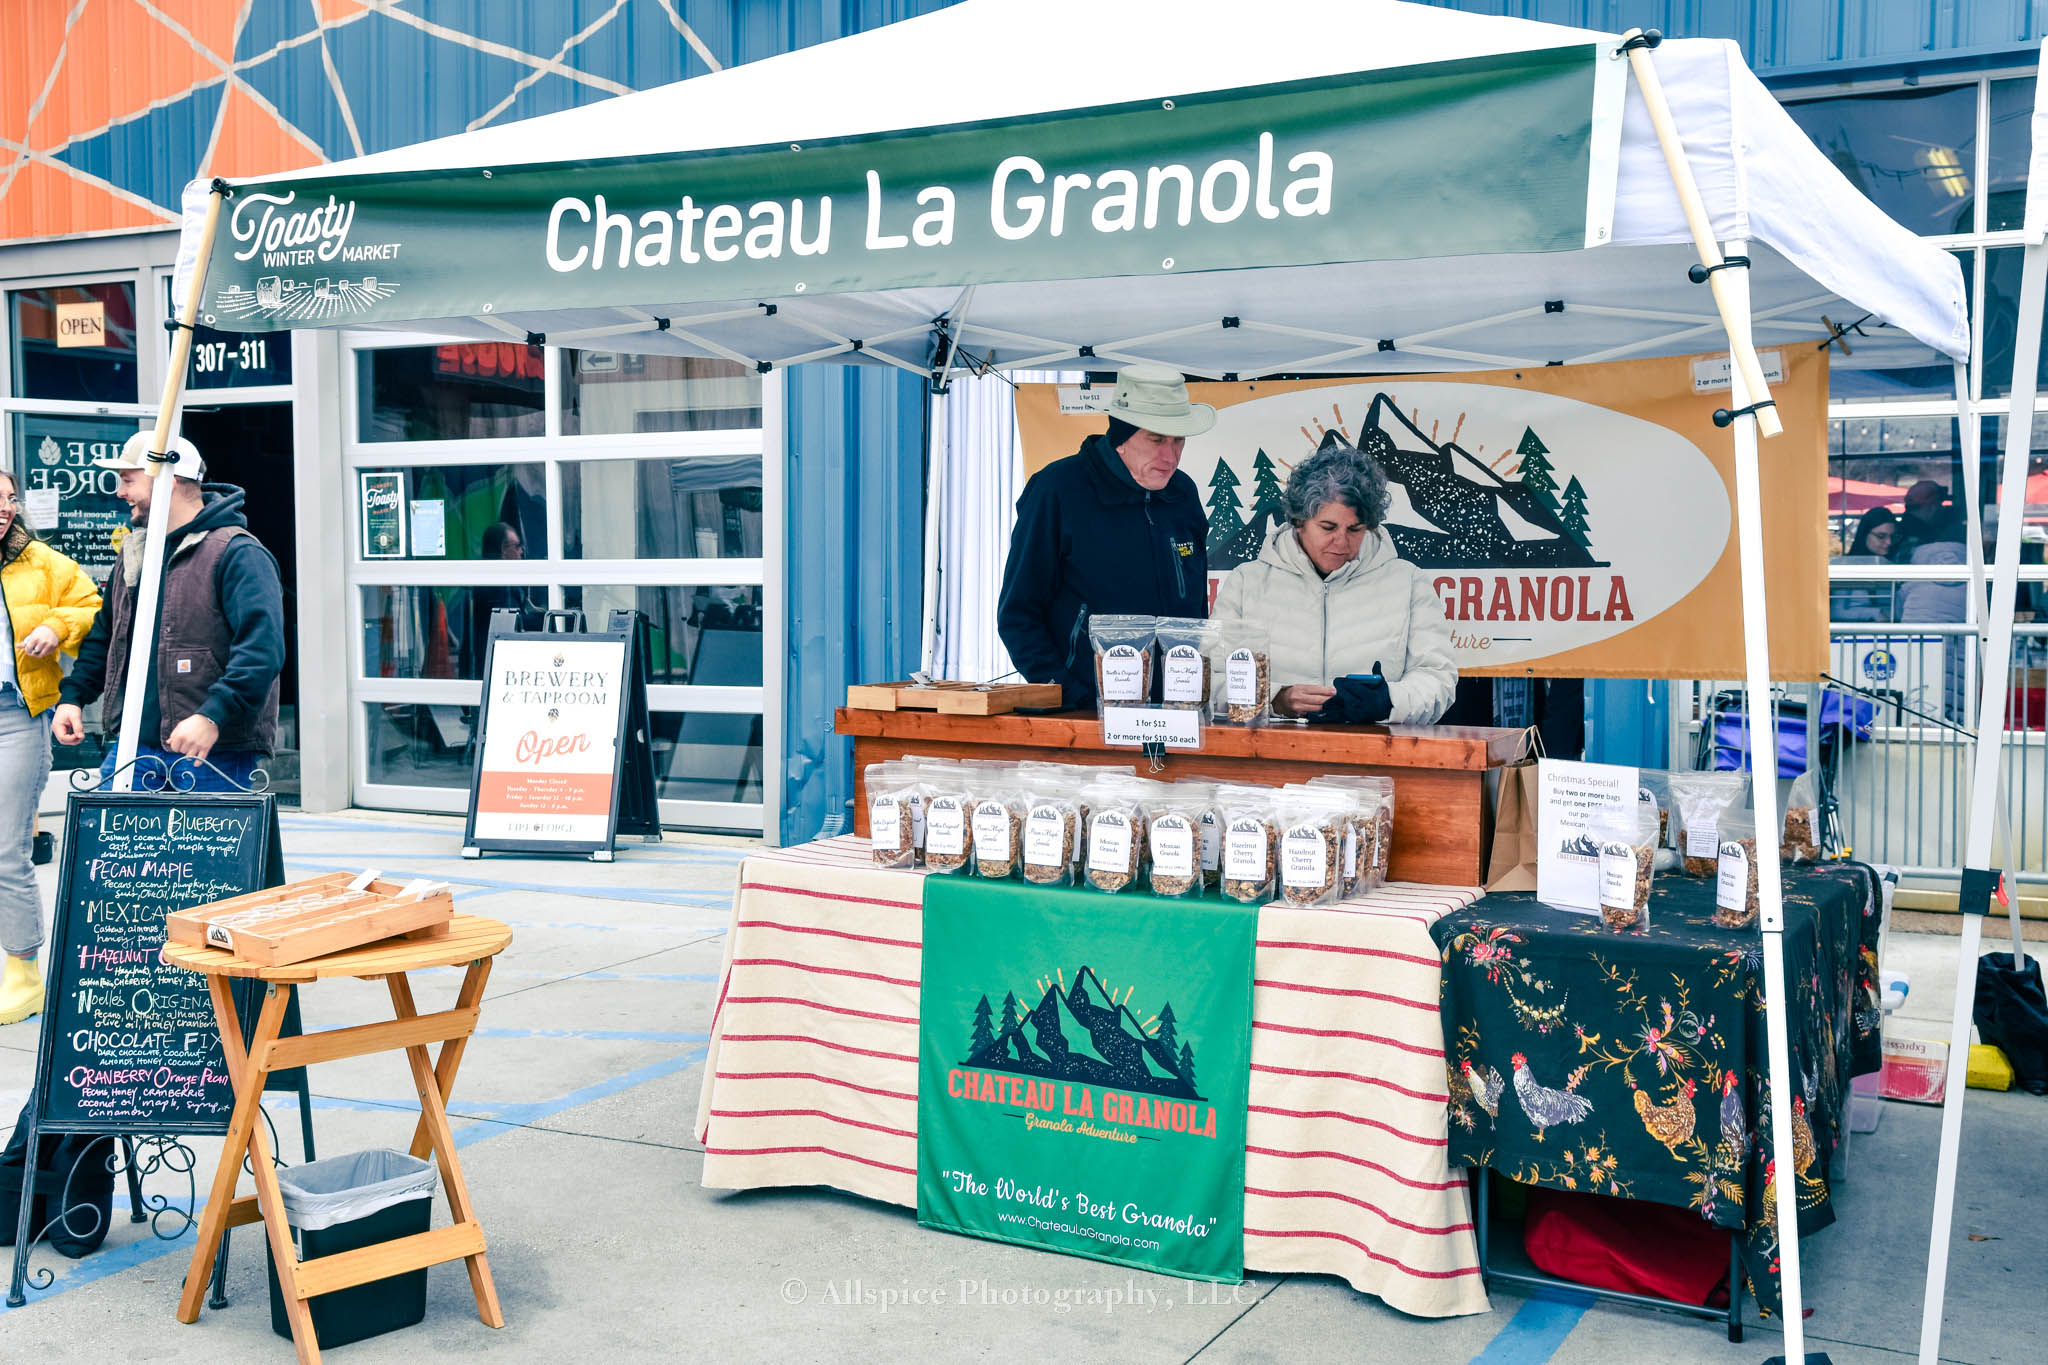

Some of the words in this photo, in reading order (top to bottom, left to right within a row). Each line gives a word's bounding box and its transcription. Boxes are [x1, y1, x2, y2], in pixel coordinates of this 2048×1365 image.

[545, 195, 832, 273] Chateau
[865, 170, 956, 251] La
[991, 131, 1334, 241] Granola
[231, 191, 355, 261] Toasty
[263, 250, 314, 268] WINTER
[342, 244, 401, 262] MARKET
[60, 317, 102, 336] OPEN
[195, 340, 266, 372] 307-311
[1433, 575, 1634, 621] GRANOLA
[504, 671, 609, 688] BREWERY
[502, 691, 514, 705] &
[521, 691, 607, 705] TAPROOM
[1135, 719, 1140, 727] 1
[1141, 719, 1152, 727] for
[1153, 719, 1167, 728] $12
[516, 730, 591, 765] Open
[1107, 732, 1112, 740] 2
[1142, 733, 1153, 741] for
[1154, 733, 1178, 743] $10.50
[1179, 735, 1197, 744] each
[1547, 773, 1586, 786] Christmas
[1587, 777, 1619, 789] Special!
[1549, 797, 1562, 805] and
[1562, 799, 1573, 808] get
[1553, 787, 1565, 796] Buy
[1566, 789, 1579, 797] two
[1587, 792, 1605, 800] more
[1606, 793, 1621, 802] bags
[1559, 819, 1586, 828] Mexican
[1232, 856, 1256, 864] Granola
[1233, 849, 1254, 857] Cherry
[1288, 848, 1316, 856] Hazelnut
[1291, 856, 1312, 864] Cherry
[1290, 863, 1315, 871] Granola
[86, 900, 180, 924] MEXICAN
[78, 945, 159, 971] HAZELNUT
[132, 988, 213, 1015] ORIGINA
[73, 1029, 176, 1051] CHOCOLATE
[70, 1065, 153, 1088] CRANBERRY
[947, 1068, 1056, 1112] CHATEAU
[1063, 1085, 1094, 1119] LA
[1102, 1091, 1217, 1140] GRANOLA
[1025, 1112, 1074, 1134] Granola
[1076, 1120, 1138, 1145] Adventure
[942, 1170, 988, 1197] "The
[995, 1176, 1071, 1212] World's
[1075, 1191, 1117, 1222] Best
[1121, 1202, 1218, 1240] Granola"
[997, 1212, 1160, 1252] www.ChateauLaGranola.com
